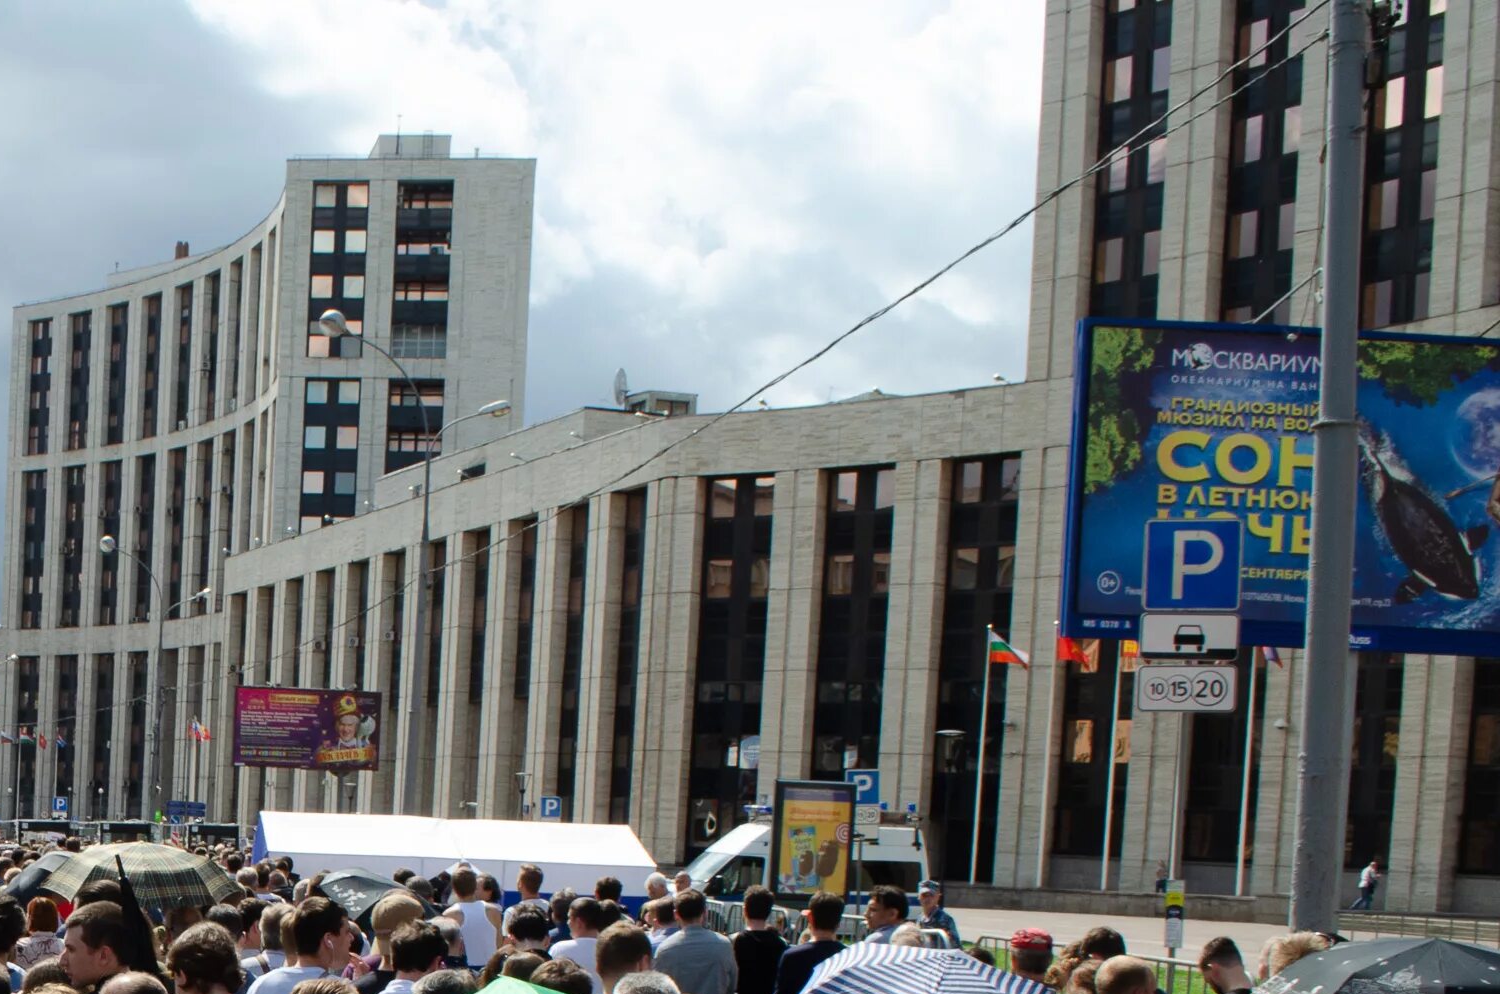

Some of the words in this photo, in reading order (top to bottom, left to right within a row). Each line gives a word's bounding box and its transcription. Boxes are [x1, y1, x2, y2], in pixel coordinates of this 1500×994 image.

[1171, 374, 1260, 389] ОКЕАНАРИУМ
[1267, 381, 1285, 389] НА
[1291, 382, 1318, 391] ВДН
[1157, 411, 1245, 428] МЮЗИКЛ
[1252, 416, 1278, 430] НА
[1156, 430, 1316, 487] СОН
[1157, 484, 1178, 504] В
[1171, 530, 1224, 600] P
[1150, 682, 1164, 695] 10
[1171, 681, 1189, 697] 15
[1195, 680, 1224, 698] 20
[853, 775, 872, 801] P
[56, 798, 66, 809] P
[545, 799, 558, 816] P
